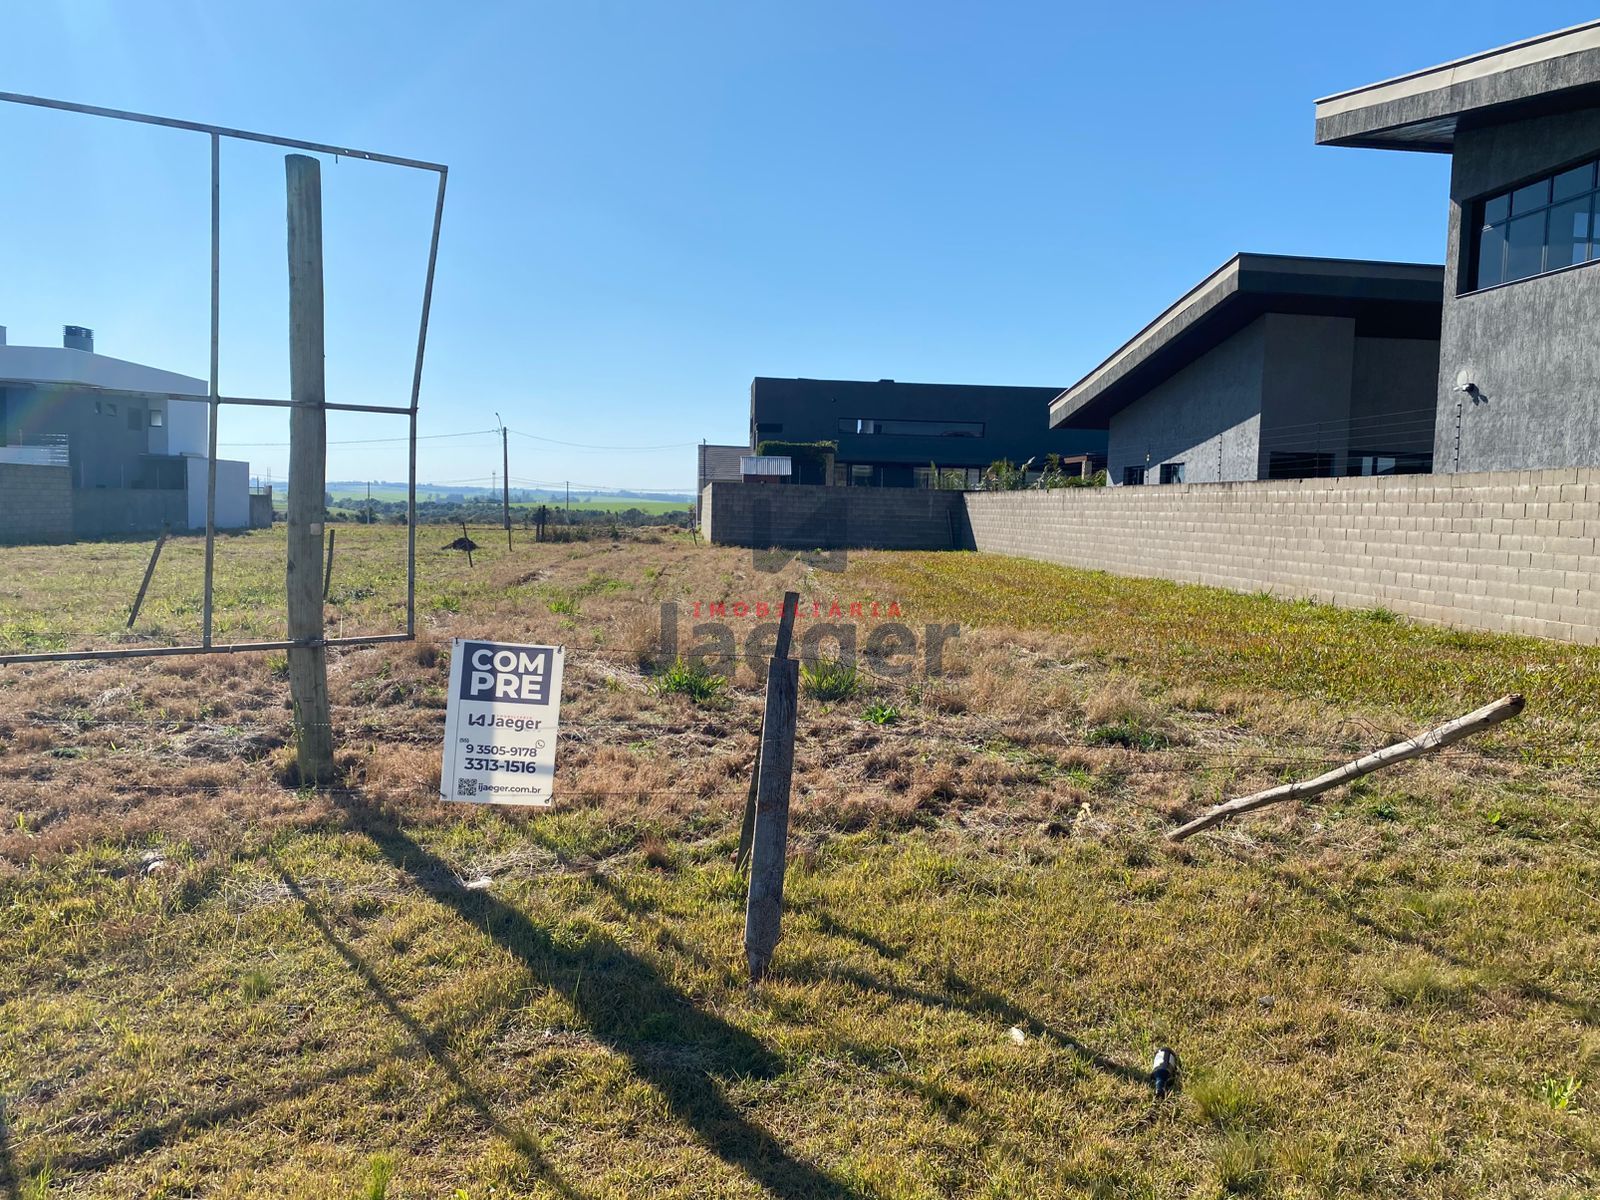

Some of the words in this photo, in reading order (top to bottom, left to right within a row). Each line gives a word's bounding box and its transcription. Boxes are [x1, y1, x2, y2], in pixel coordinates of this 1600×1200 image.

[471, 649, 546, 675] COM
[470, 671, 543, 700] PRE
[487, 714, 542, 732] Jaeger
[465, 743, 474, 754] 9
[476, 744, 538, 758] 3505-9178
[464, 757, 536, 774] 3313-1516
